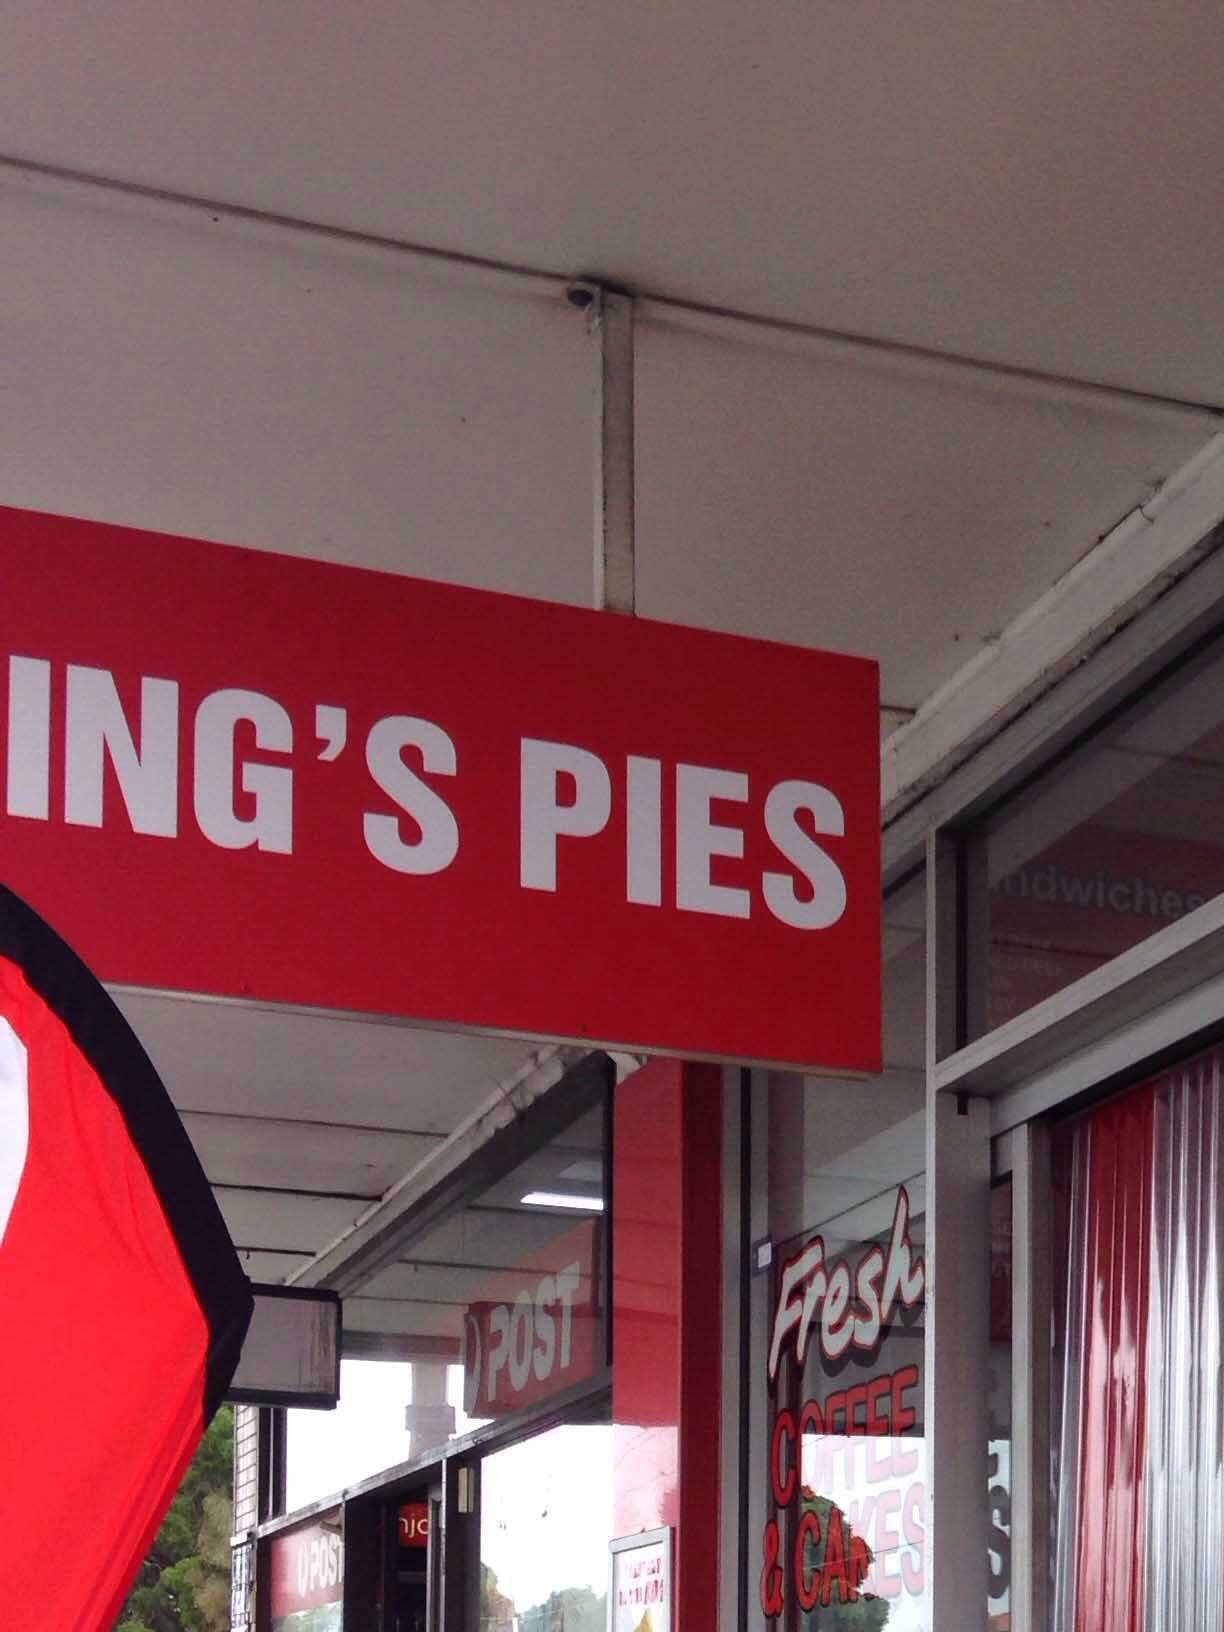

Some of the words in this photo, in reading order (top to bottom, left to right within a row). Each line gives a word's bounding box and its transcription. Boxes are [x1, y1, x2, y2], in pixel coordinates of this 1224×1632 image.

[6, 654, 460, 876] ING'S
[519, 736, 847, 930] PIES
[487, 1261, 581, 1403] POST
[766, 1183, 926, 1382] Fresh
[769, 1364, 920, 1508] COFFEE
[760, 1519, 784, 1617] &
[795, 1481, 927, 1612] CAKES
